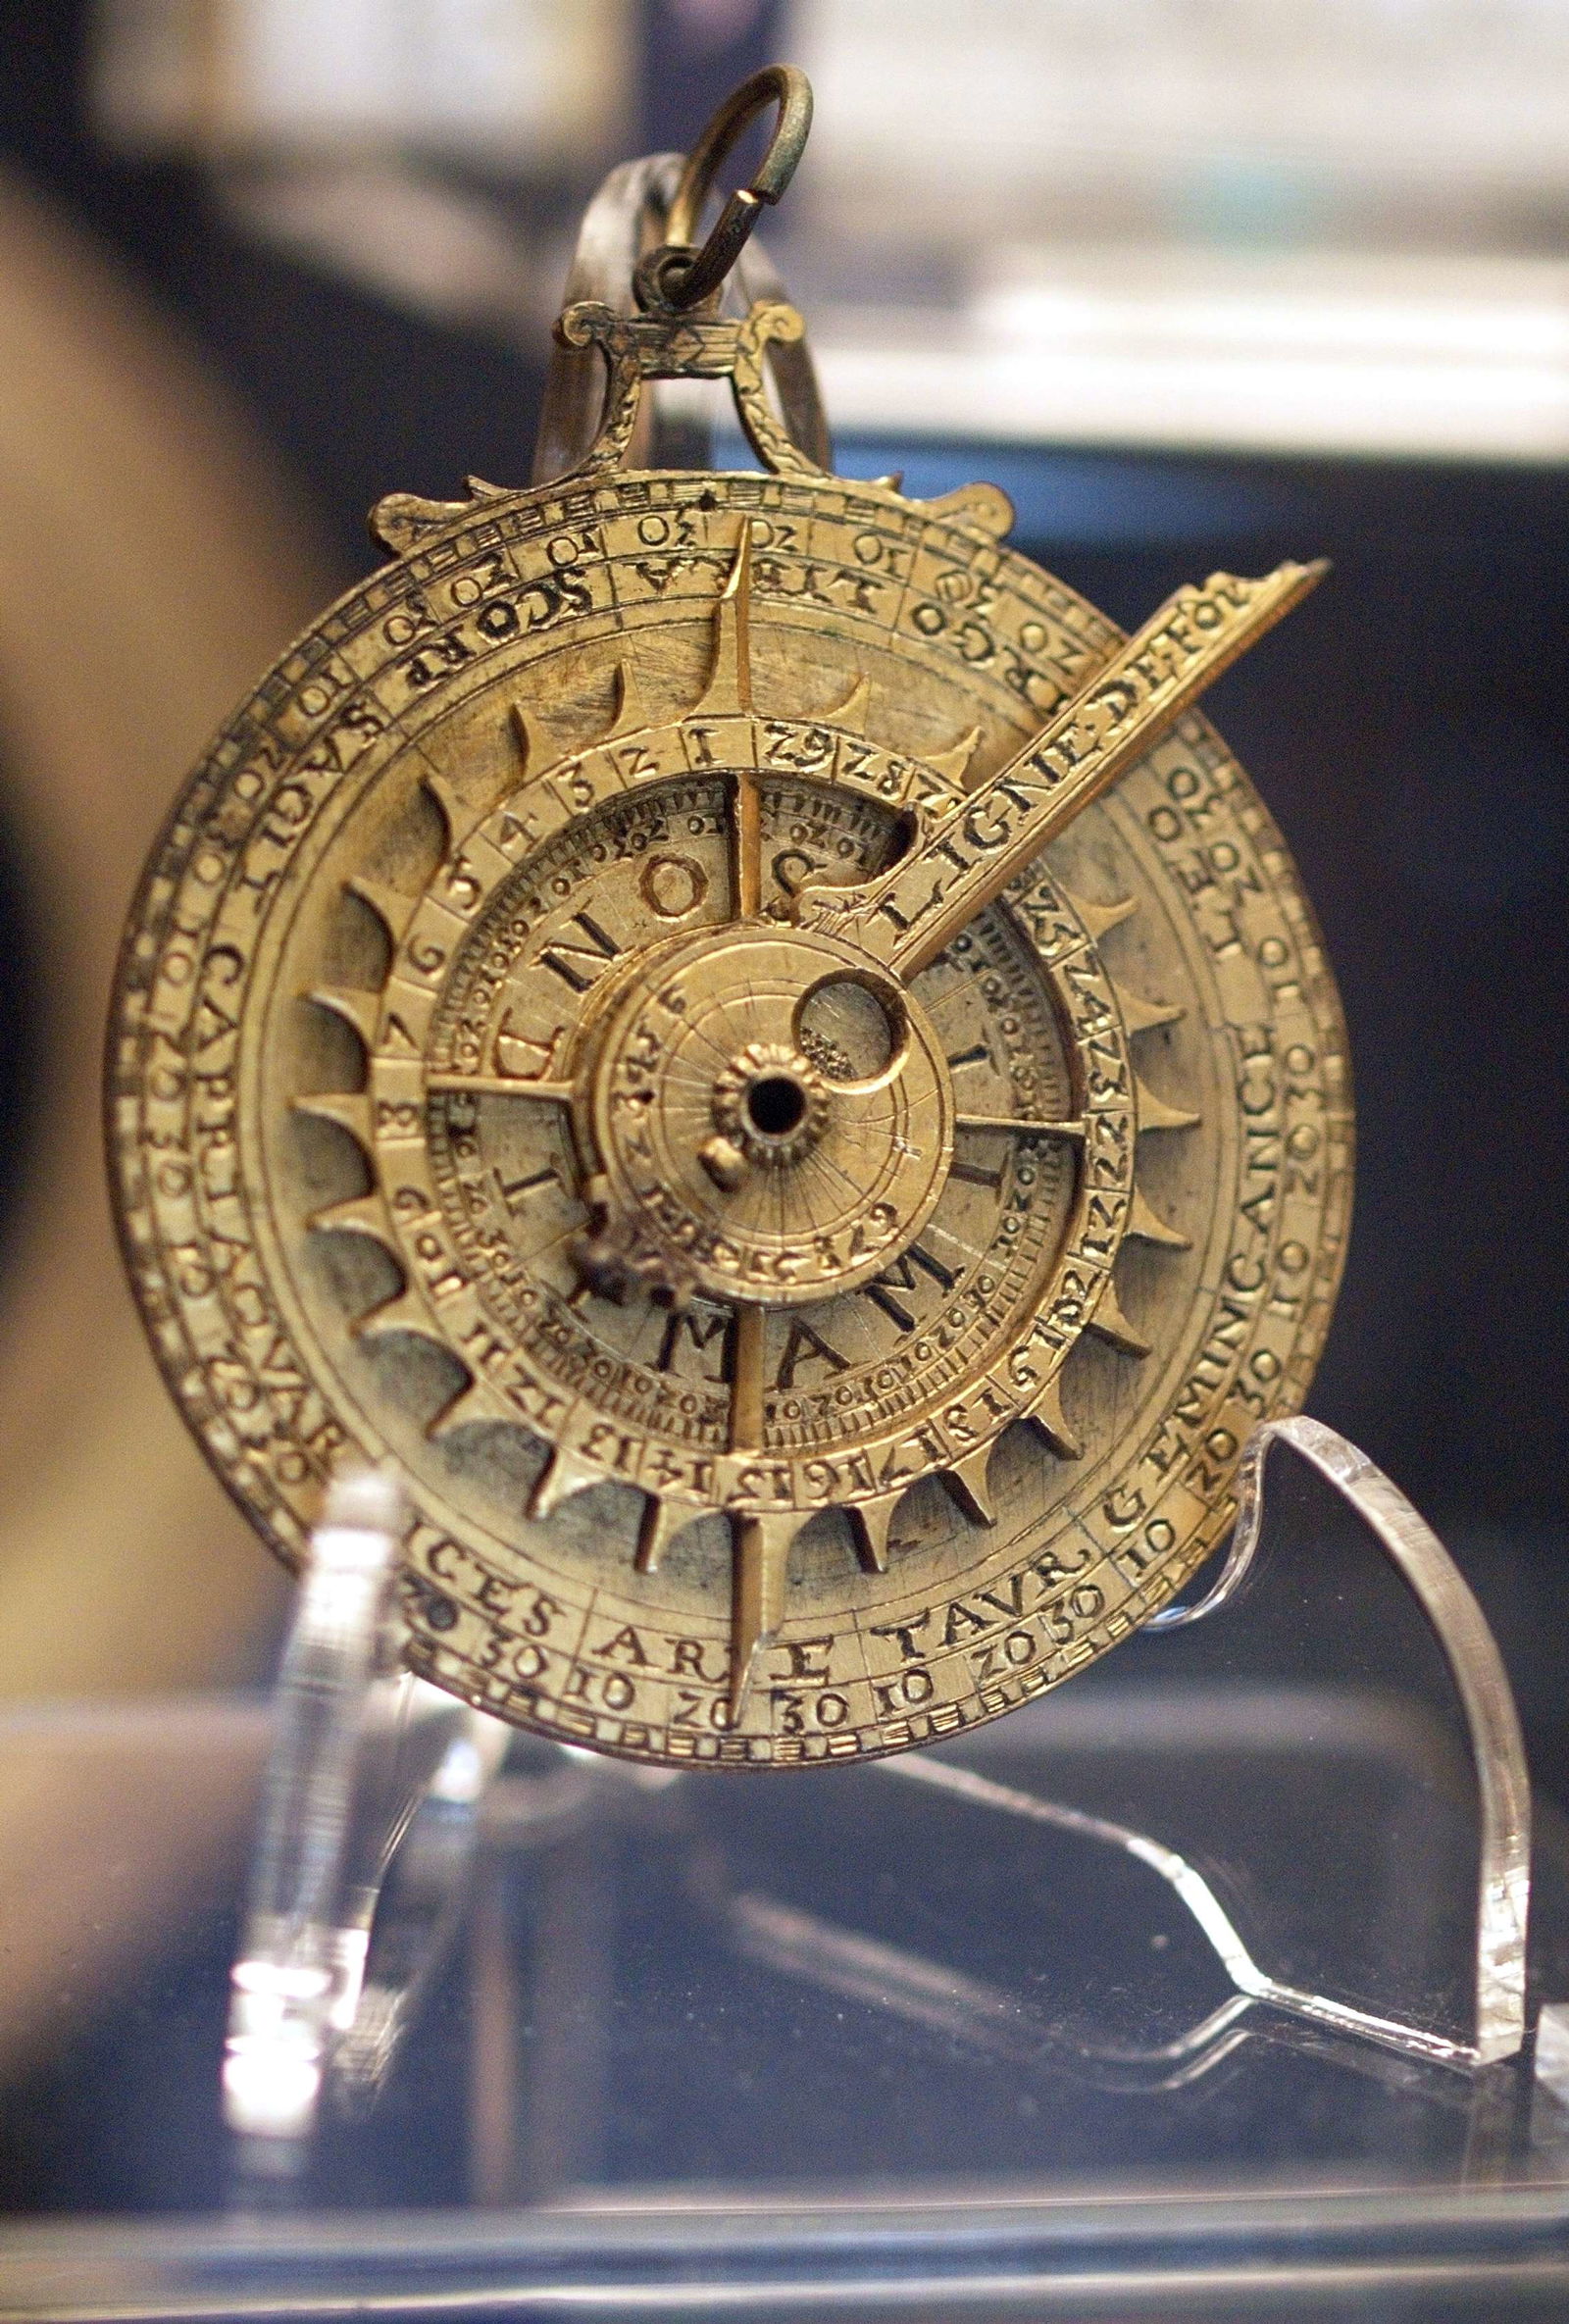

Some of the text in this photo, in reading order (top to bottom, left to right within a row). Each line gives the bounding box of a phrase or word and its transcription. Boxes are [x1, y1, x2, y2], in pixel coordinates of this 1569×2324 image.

[405, 567, 593, 688] SCORP
[763, 723, 836, 771] 29
[639, 852, 708, 922] O
[1104, 1294, 1253, 1535] GEMIN
[1183, 1426, 1241, 1494] 20
[1120, 1515, 1180, 1578] 10
[1040, 1579, 1109, 1644] 30
[566, 1662, 637, 1711] 10
[972, 1627, 1039, 1683] 20
[772, 1684, 850, 1737] 30
[873, 1667, 936, 1717] 10
